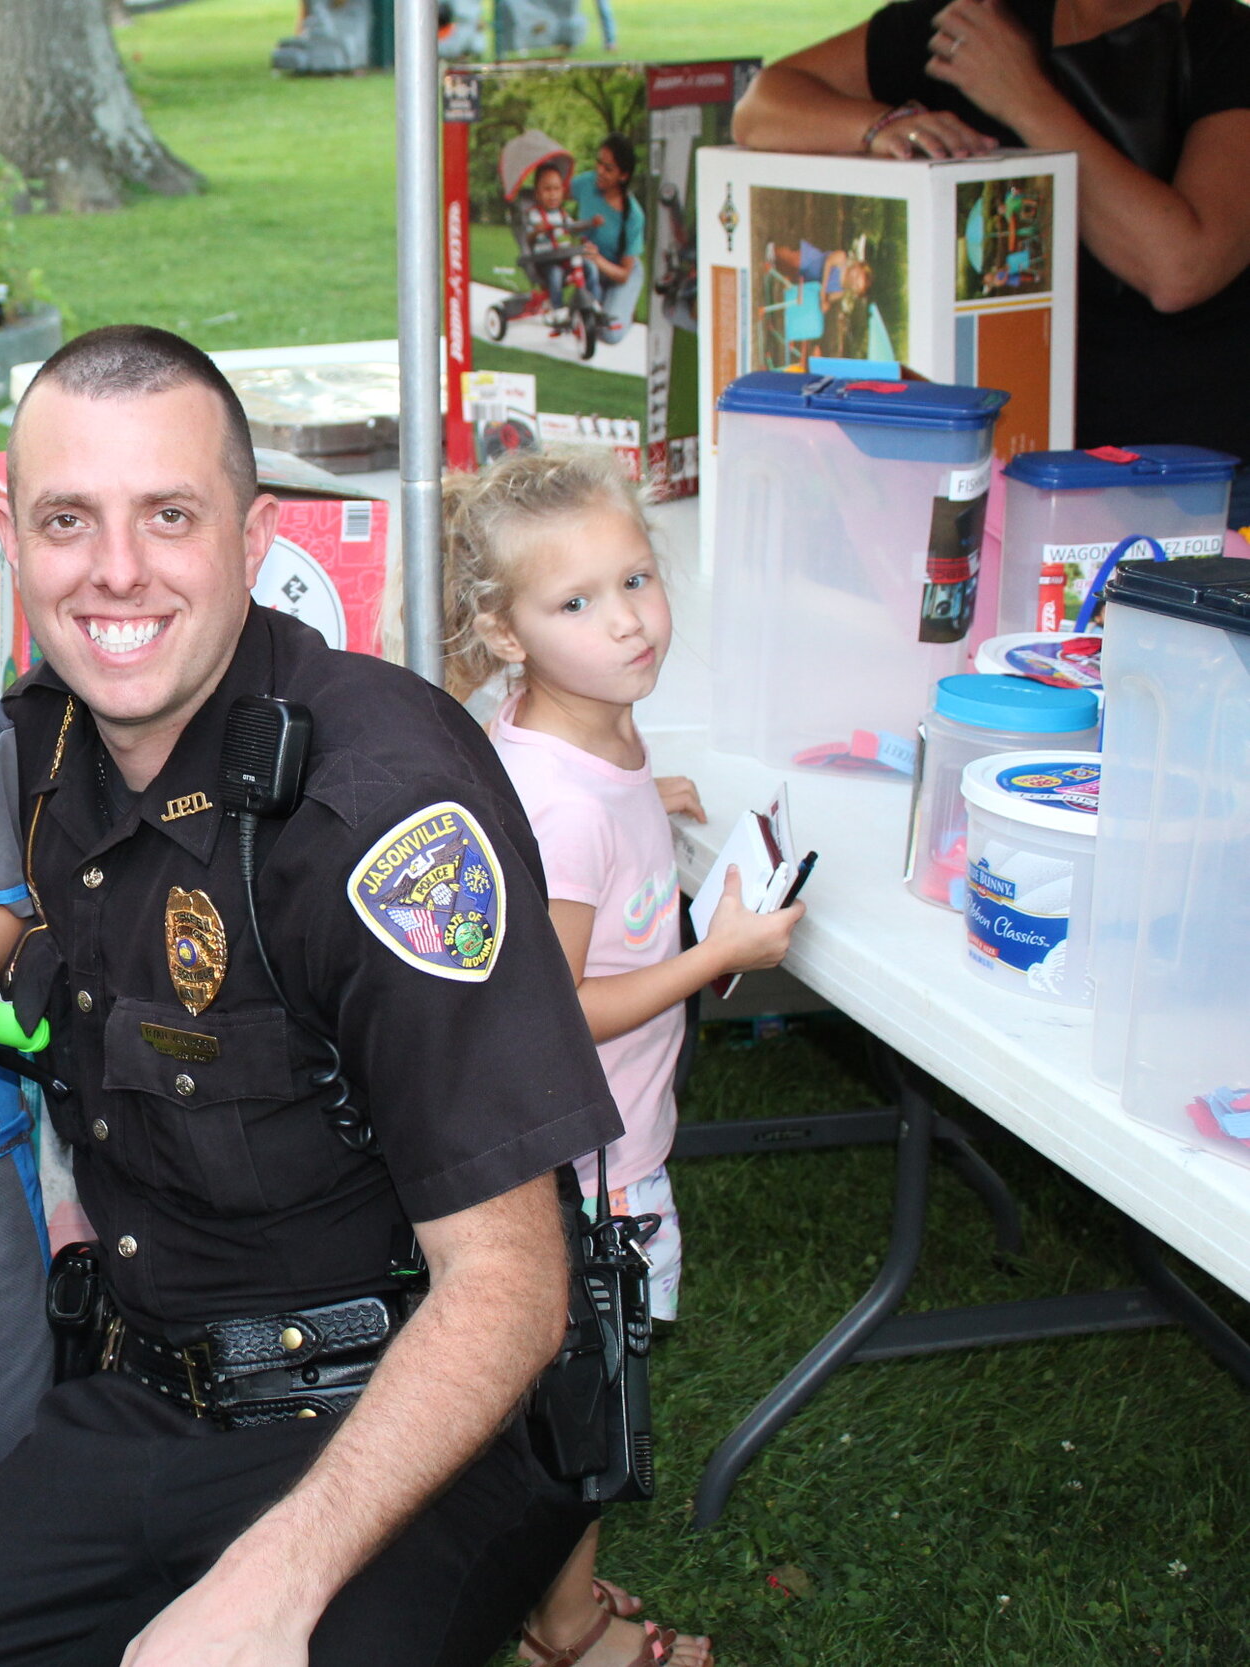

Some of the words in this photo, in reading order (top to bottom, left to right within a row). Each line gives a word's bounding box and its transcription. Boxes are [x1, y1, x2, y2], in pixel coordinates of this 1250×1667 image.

[1131, 543, 1147, 557] IN
[1184, 537, 1221, 554] FOLD
[363, 814, 457, 895] JASONVILLE
[416, 866, 449, 896] POLICE
[443, 912, 464, 946] STATE
[468, 911, 483, 922] OF
[994, 915, 1046, 946] Classics
[461, 937, 493, 968] INDIANA
